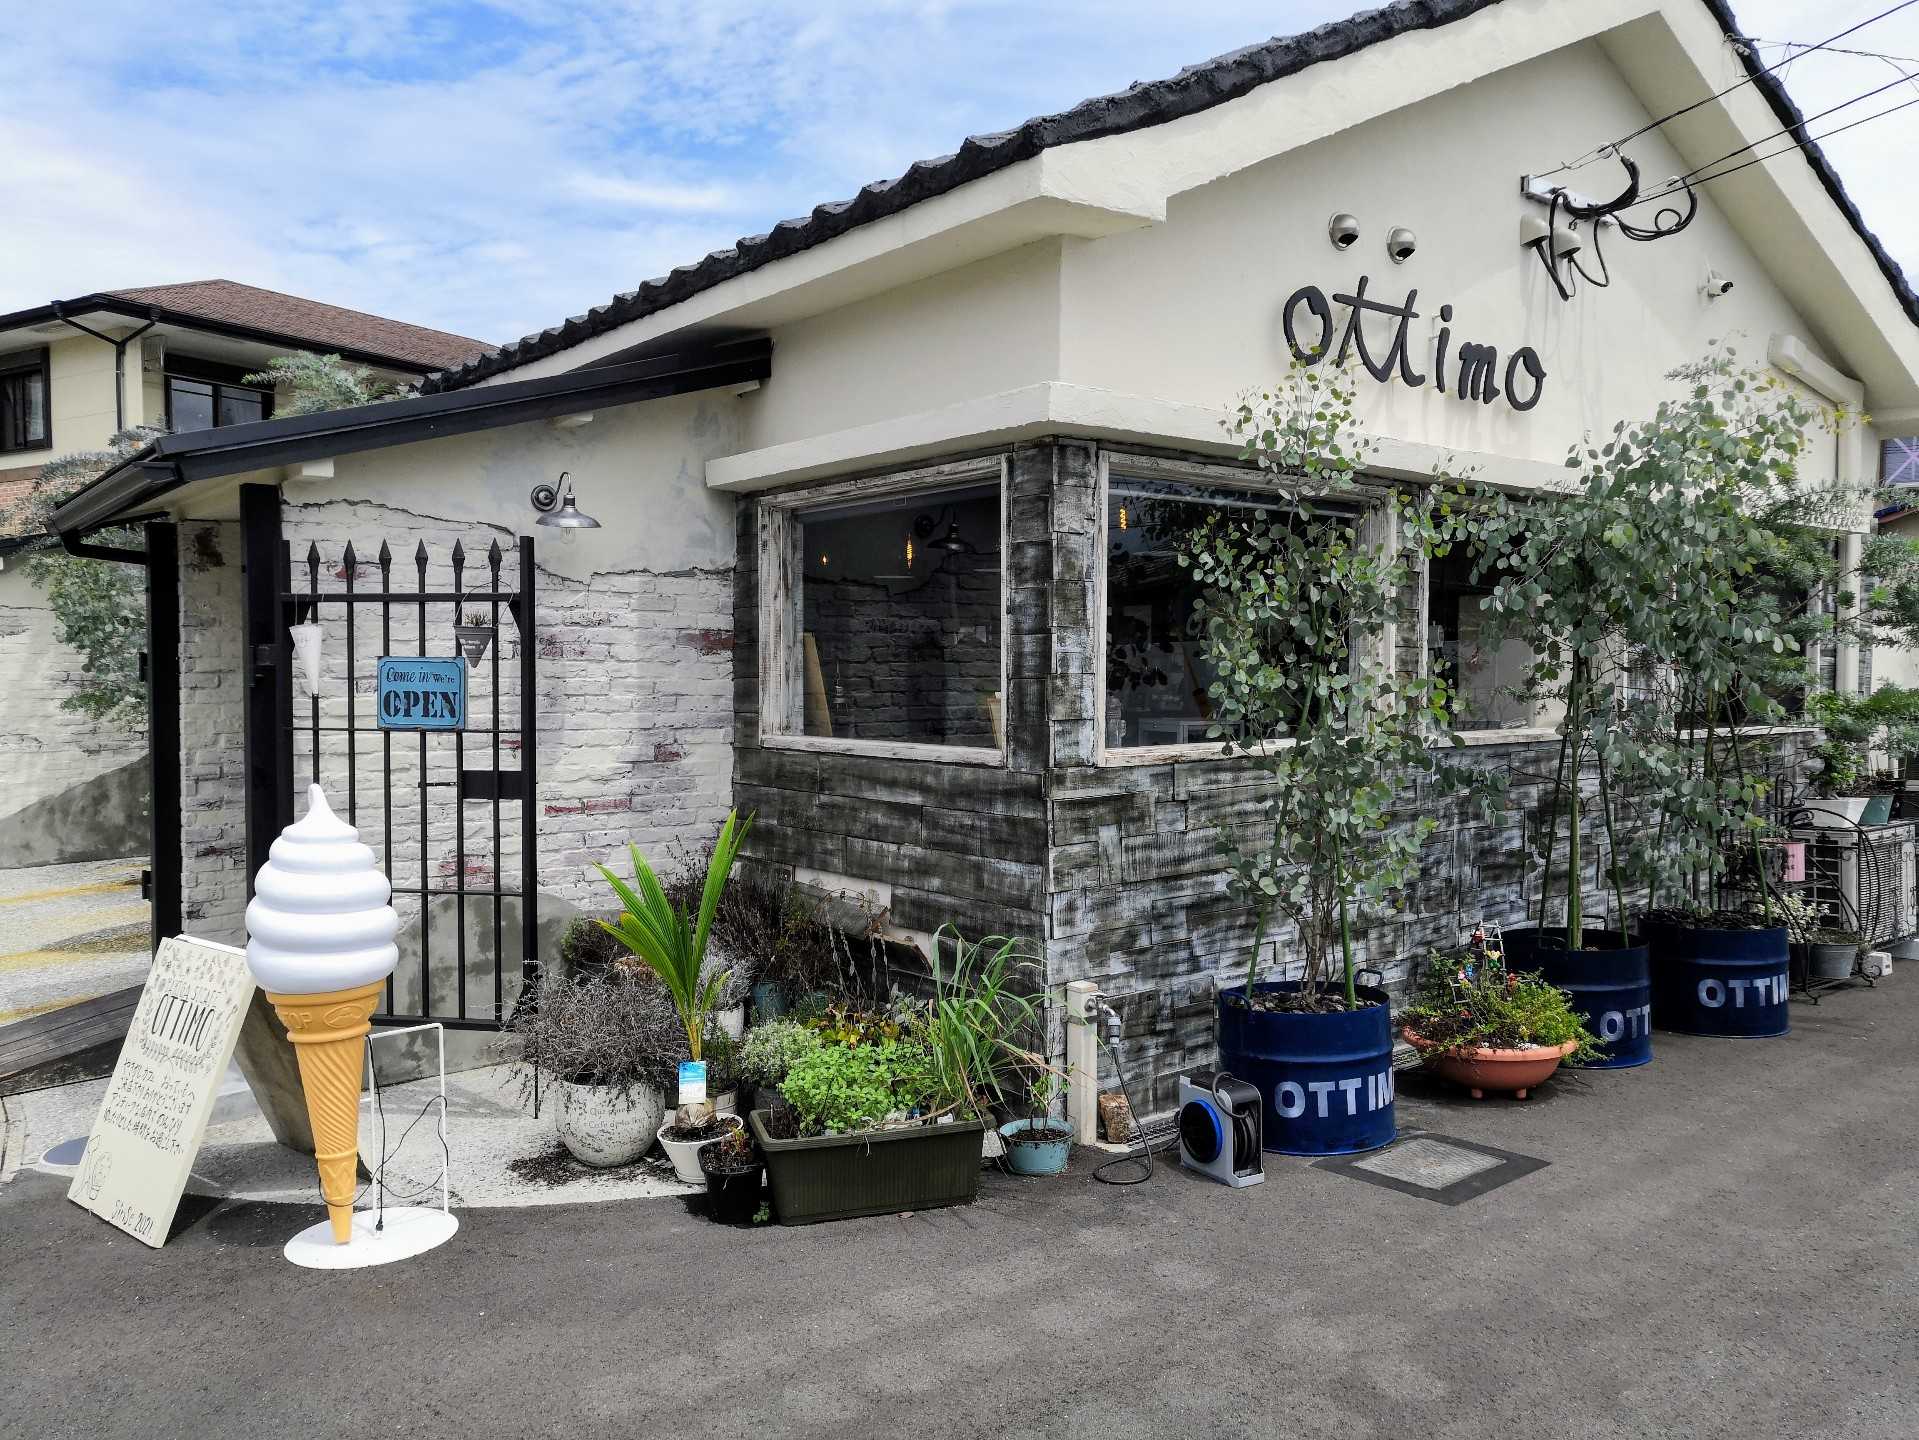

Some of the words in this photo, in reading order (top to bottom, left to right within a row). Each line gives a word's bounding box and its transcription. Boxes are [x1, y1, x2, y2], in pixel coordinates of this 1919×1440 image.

[386, 666, 417, 683] Come
[418, 666, 430, 683] in
[383, 690, 458, 718] OPEN
[151, 993, 216, 1052] OTTIMO
[1600, 1003, 1651, 1042] OTT
